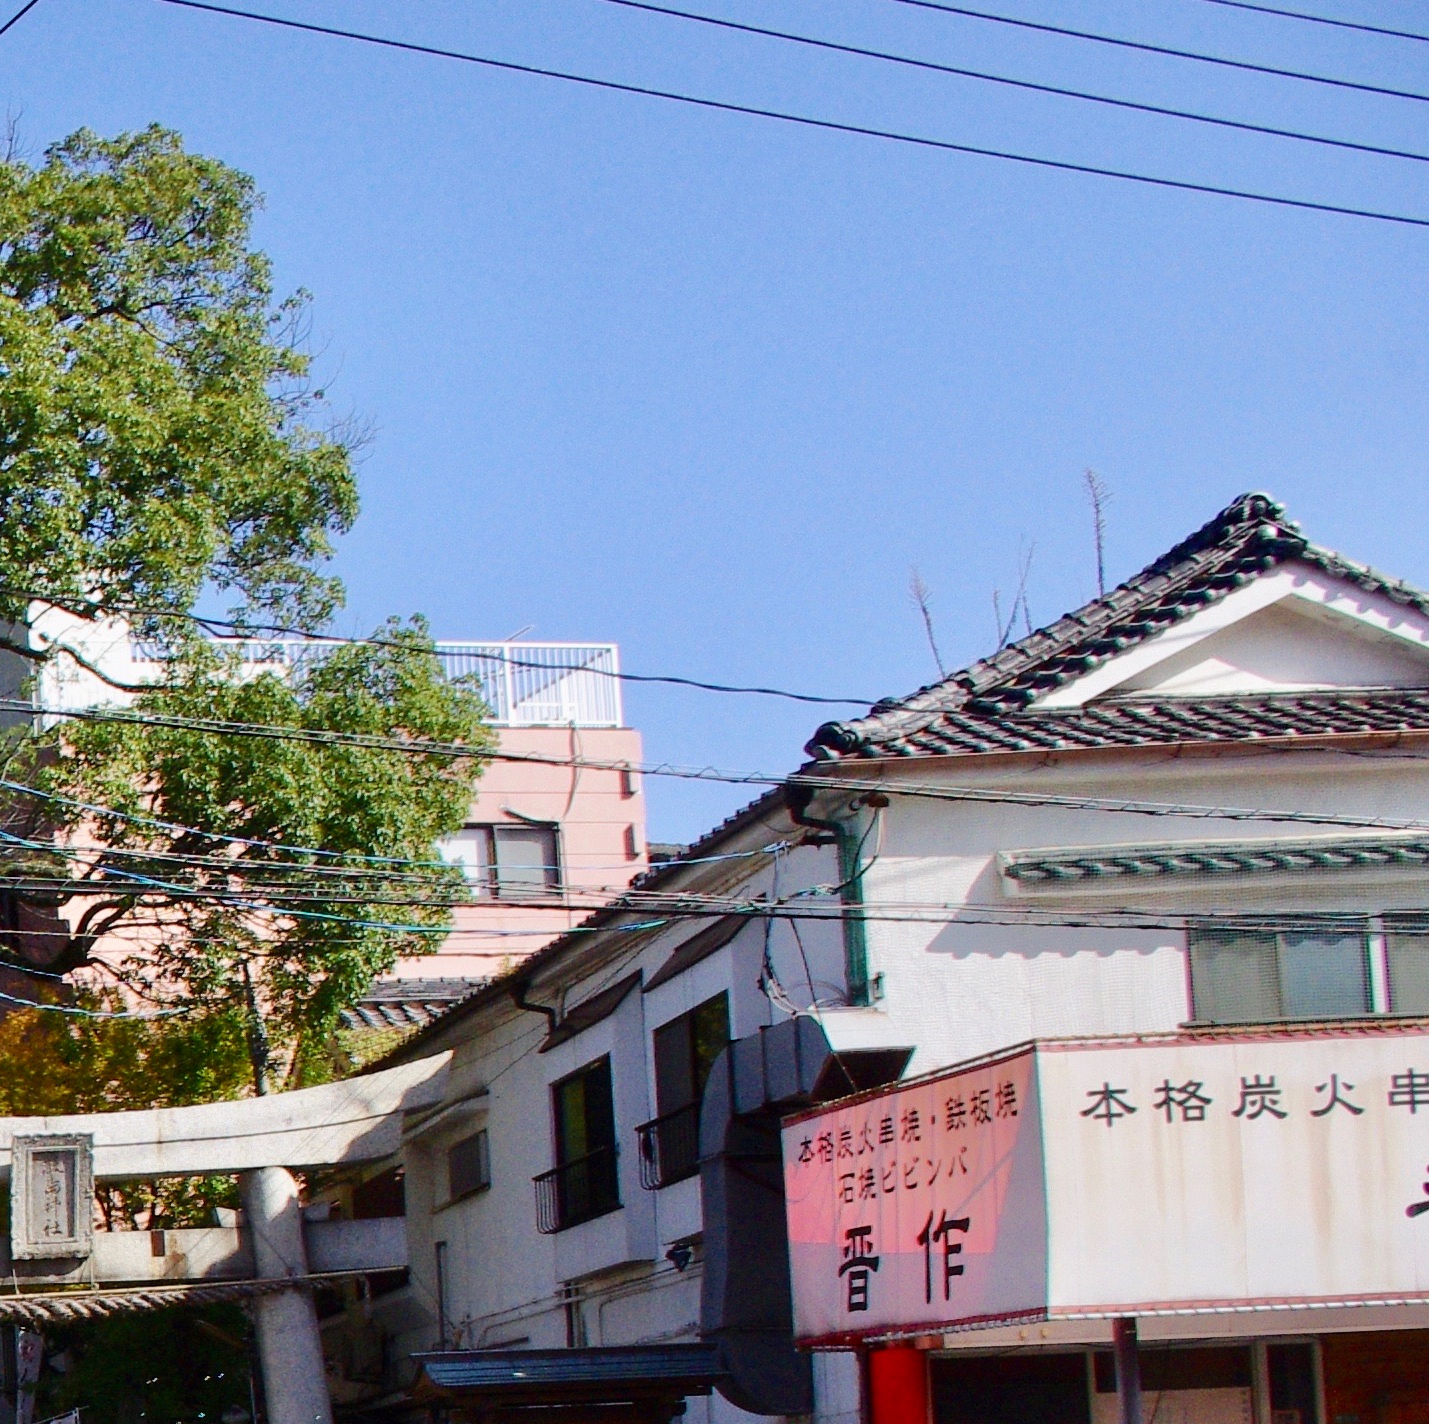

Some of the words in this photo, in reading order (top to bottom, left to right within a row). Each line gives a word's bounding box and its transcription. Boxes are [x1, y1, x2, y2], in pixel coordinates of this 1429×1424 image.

[798, 1080, 1018, 1163] 本格炭火串焼・鉄板焼
[1079, 1067, 1429, 1128] 本格炭火串
[838, 1208, 970, 1312] 晋作
